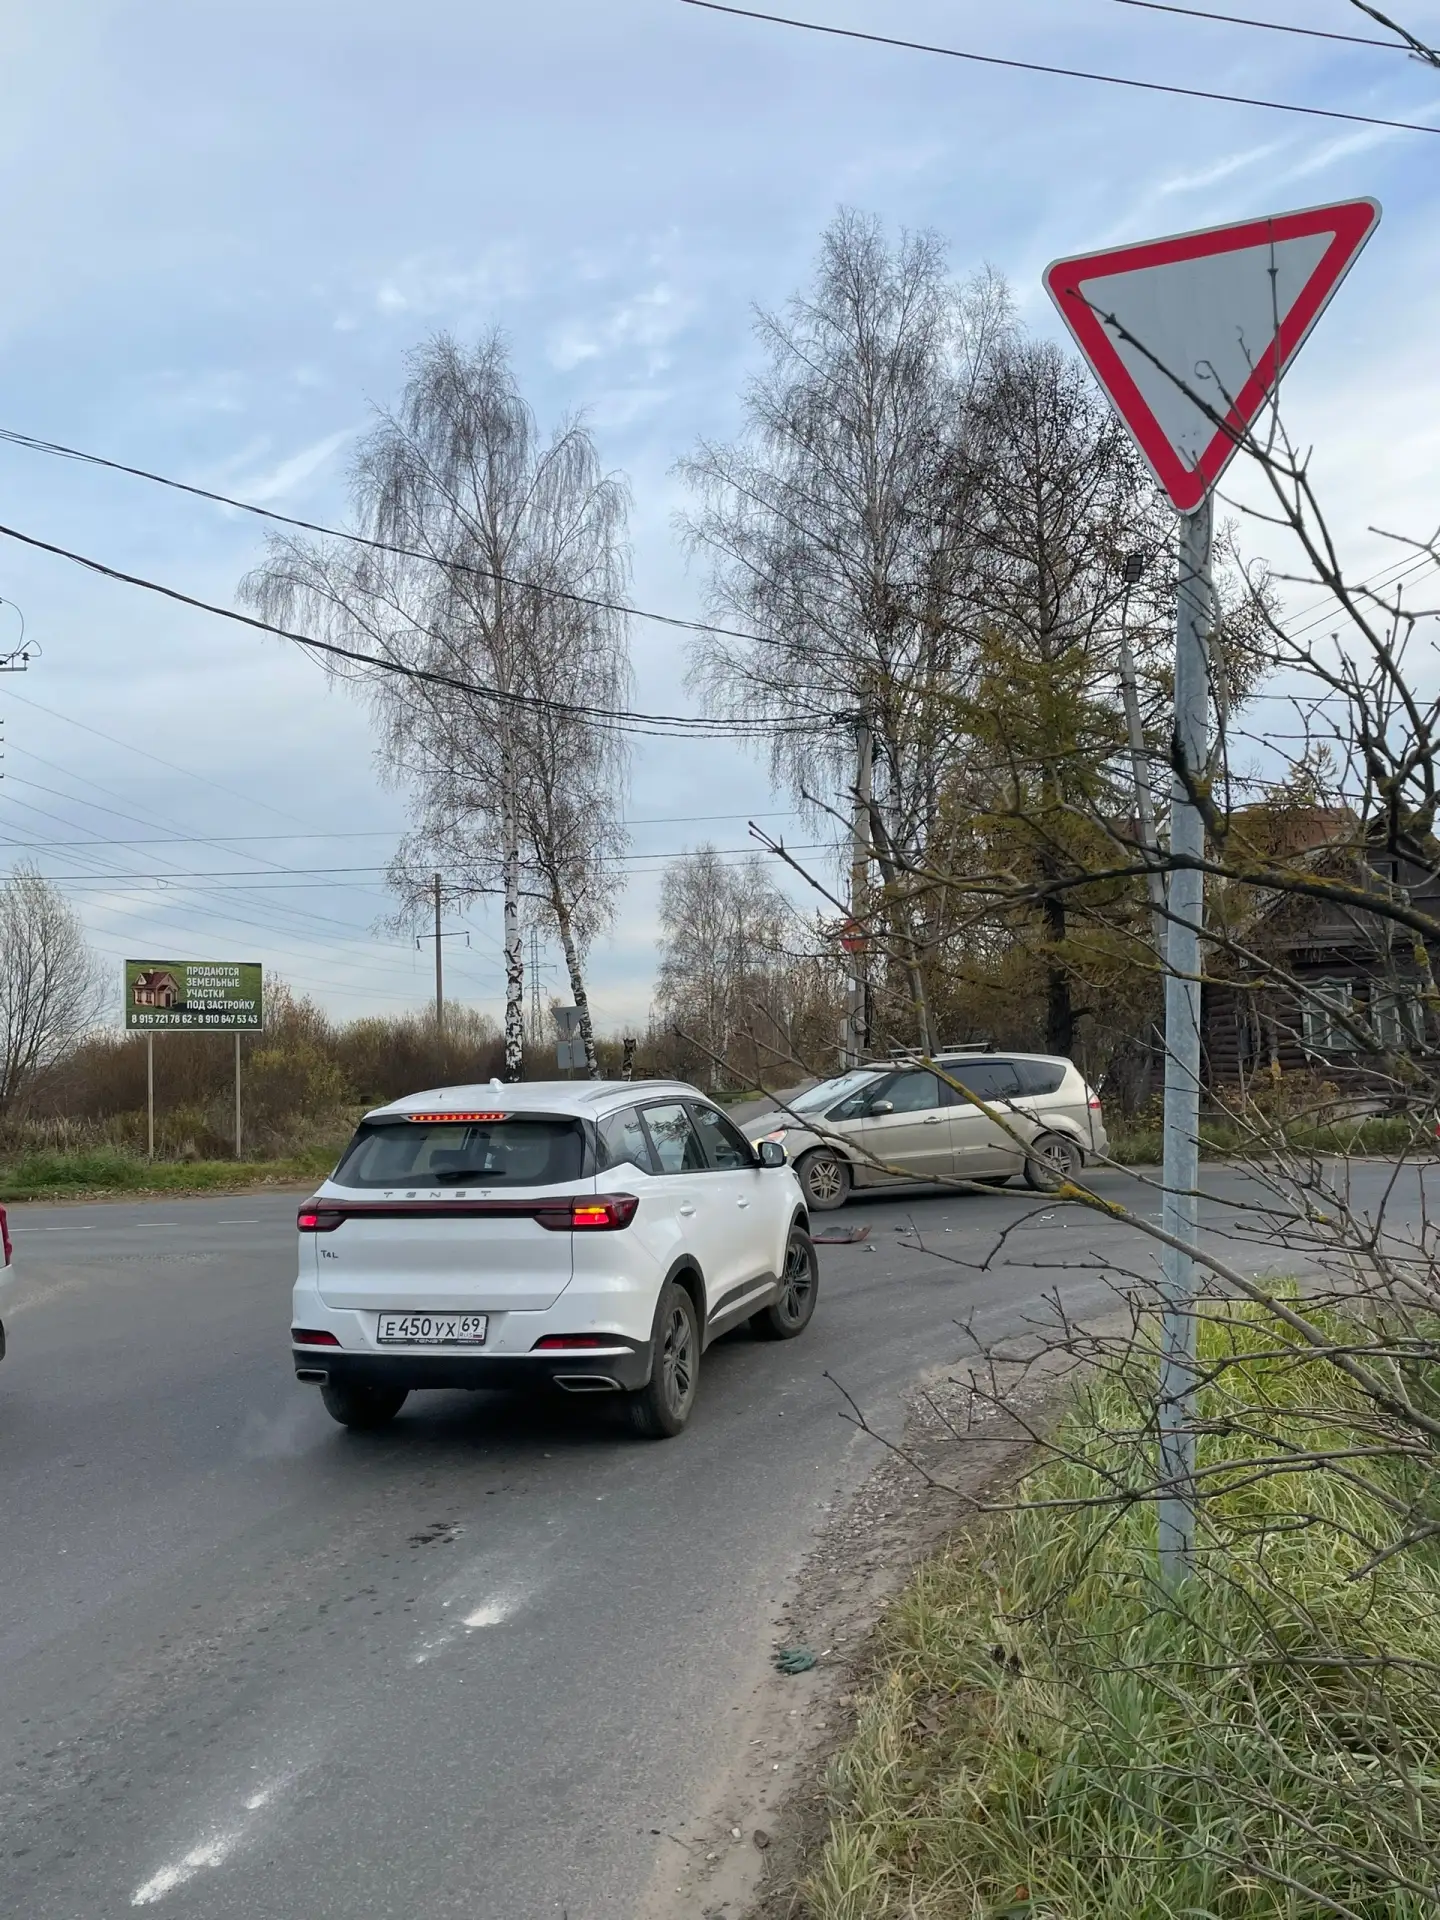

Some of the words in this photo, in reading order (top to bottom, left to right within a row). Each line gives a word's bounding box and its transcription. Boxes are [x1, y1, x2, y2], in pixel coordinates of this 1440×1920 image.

[186, 966, 240, 977] ПРОДАЮТСЯ
[186, 977, 240, 988] ЗЕМЕЛЬНЫЕ
[186, 988, 225, 998] УЧАСТКИ
[186, 1000, 206, 1011] ПОД
[207, 998, 255, 1010] ЗАСТРОЙКУ
[139, 1014, 153, 1024] 915
[155, 1014, 169, 1024] 721
[170, 1014, 180, 1024] 78
[182, 1014, 192, 1024] 62
[205, 1014, 219, 1024] 910
[221, 1014, 235, 1024] 647
[237, 1014, 246, 1024] 53
[248, 1014, 258, 1024] 43
[383, 1190, 492, 1199] TENET
[320, 1250, 339, 1259] T4L
[461, 1317, 480, 1332] 69
